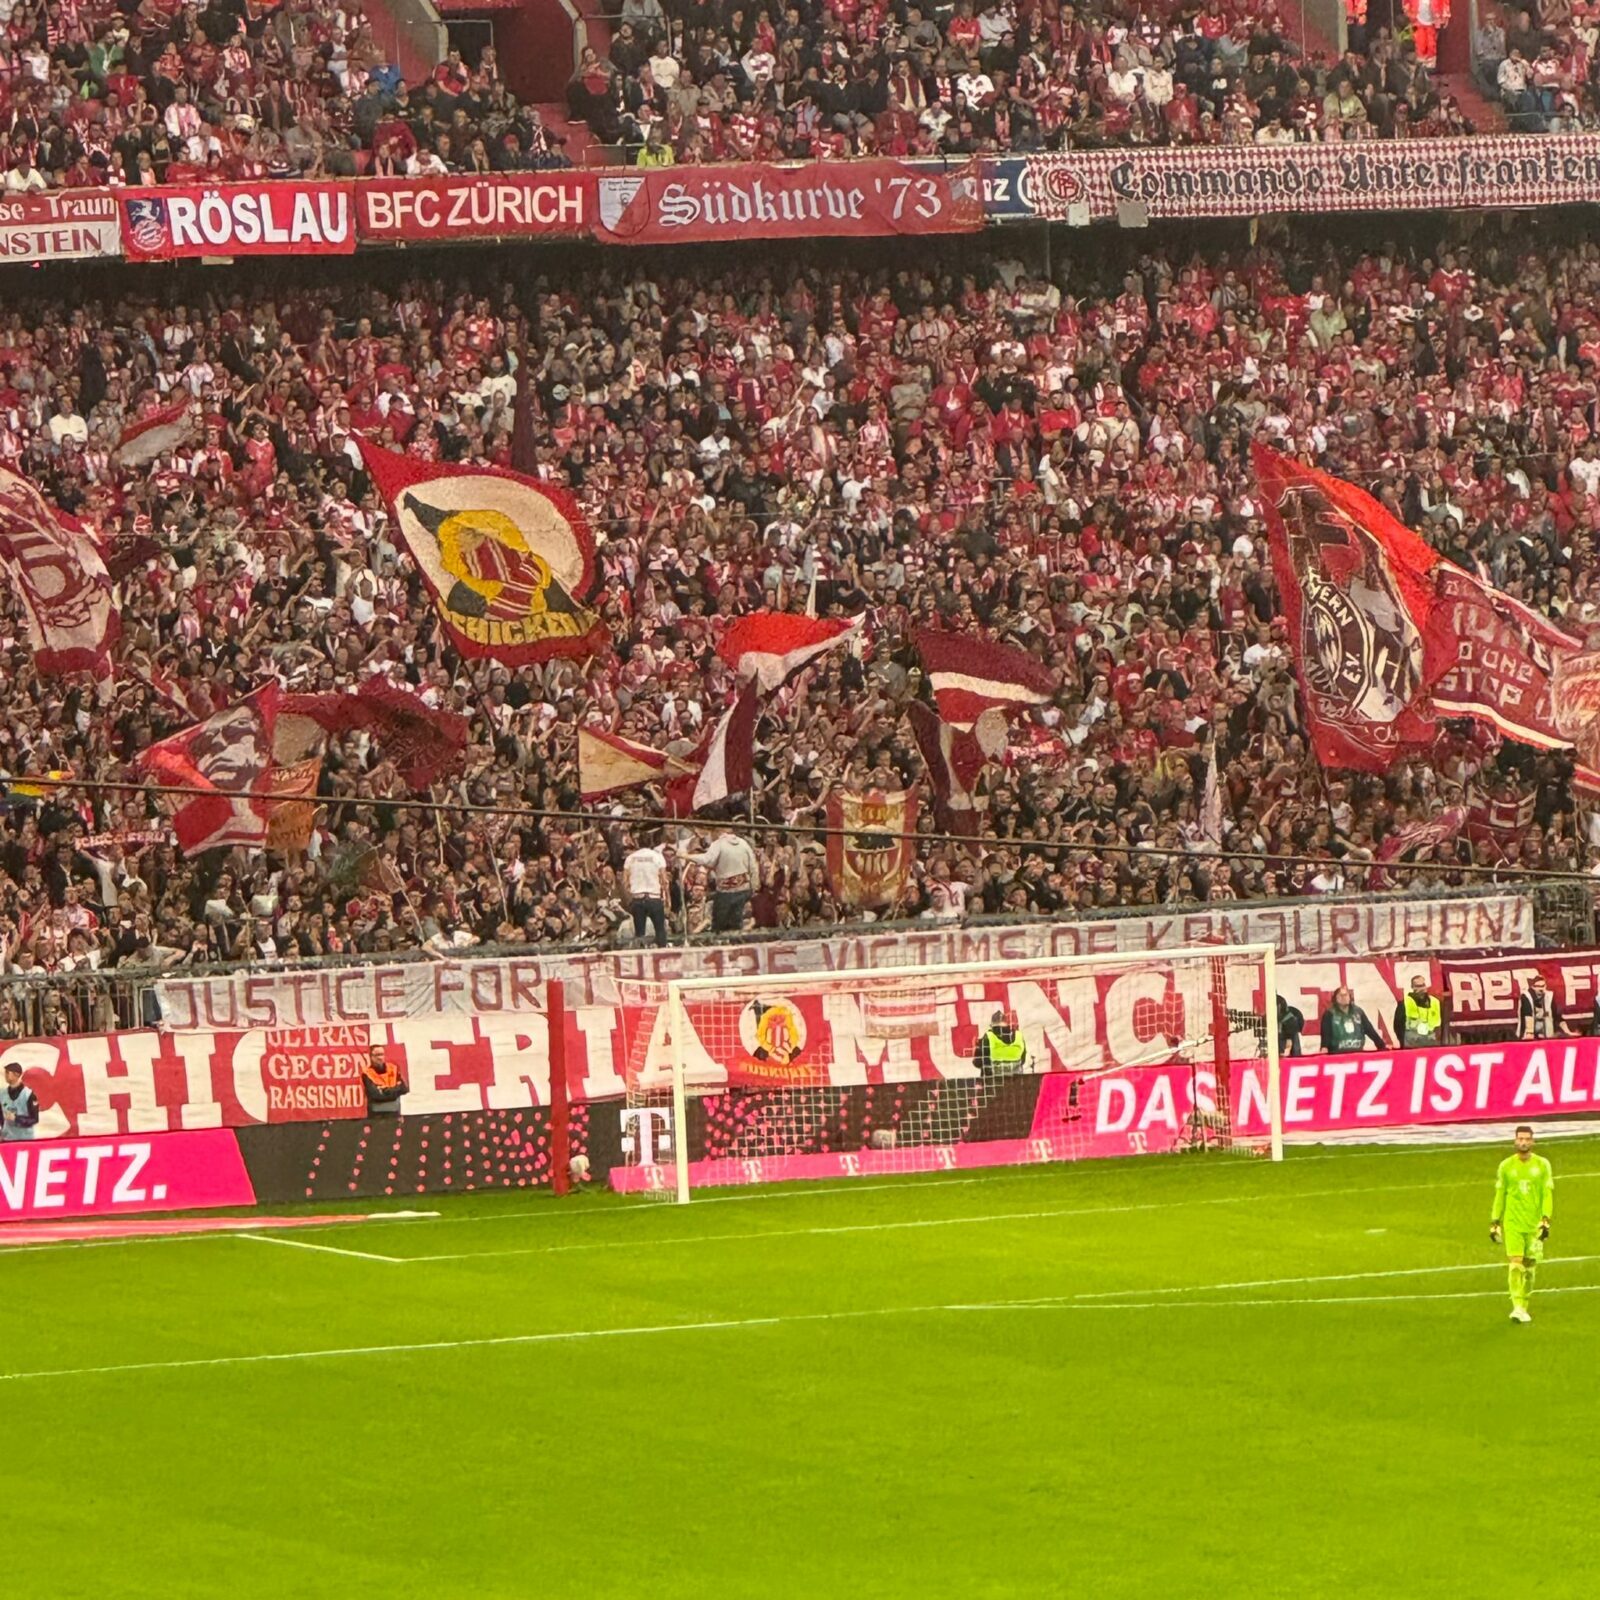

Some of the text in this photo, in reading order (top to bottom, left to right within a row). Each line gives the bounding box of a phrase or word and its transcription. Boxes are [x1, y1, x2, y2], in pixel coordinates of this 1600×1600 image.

[168, 190, 347, 246] RÖSLAU
[368, 182, 583, 229] BFC ZÜRICH
[658, 180, 865, 226] Südkurve
[165, 969, 407, 1029] JUSTICE
[434, 960, 542, 1012] FOR
[268, 1025, 369, 1048] ULTRAS
[268, 1052, 371, 1080] GEGEN
[270, 1084, 364, 1109] RASSISMU
[1095, 1046, 1600, 1134] DAS NETZ IST AL
